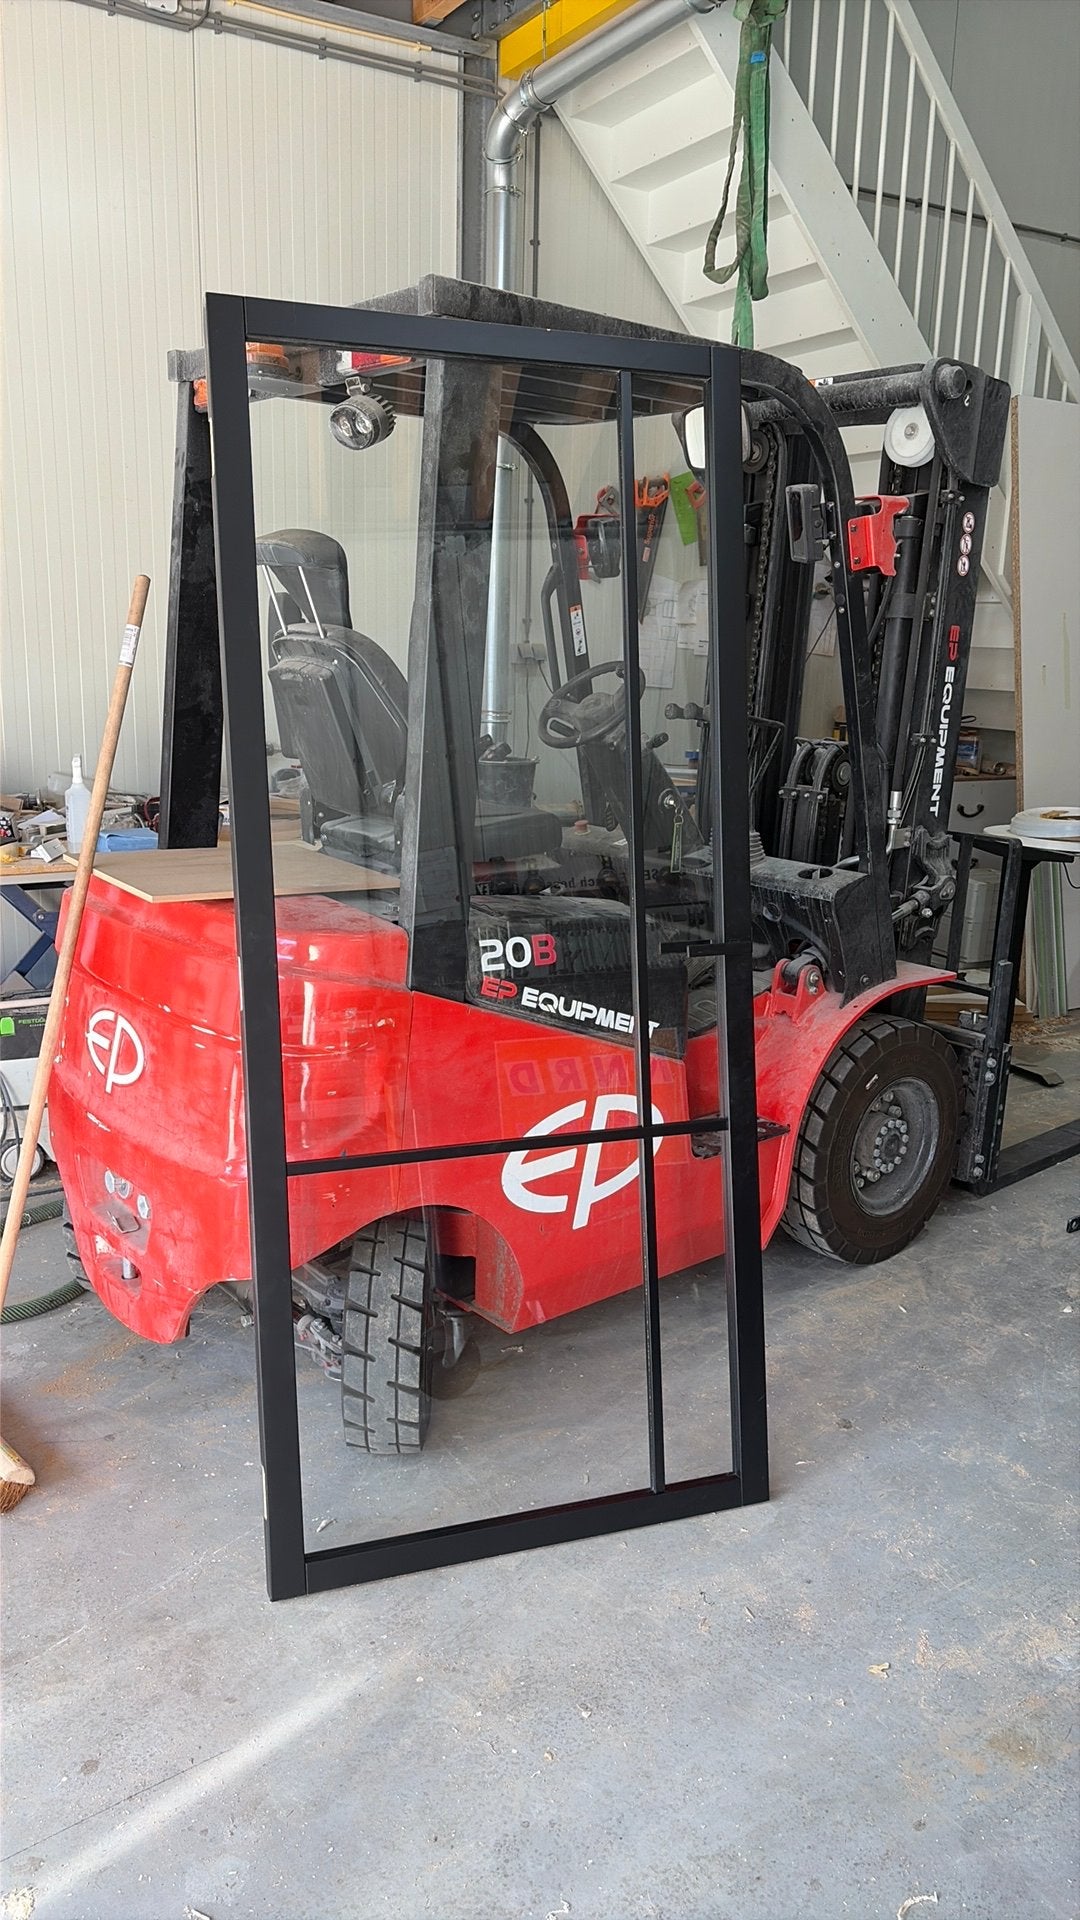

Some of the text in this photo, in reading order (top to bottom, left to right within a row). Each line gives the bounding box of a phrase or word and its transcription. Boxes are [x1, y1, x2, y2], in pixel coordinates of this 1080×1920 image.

[929, 625, 960, 818] EP EQUIPMENT
[479, 934, 557, 972] 20B
[18, 1017, 46, 1025] FESTOO
[480, 975, 660, 1039] EP EQUIPMET
[85, 1009, 145, 1095] EP
[501, 1094, 664, 1230] EP
